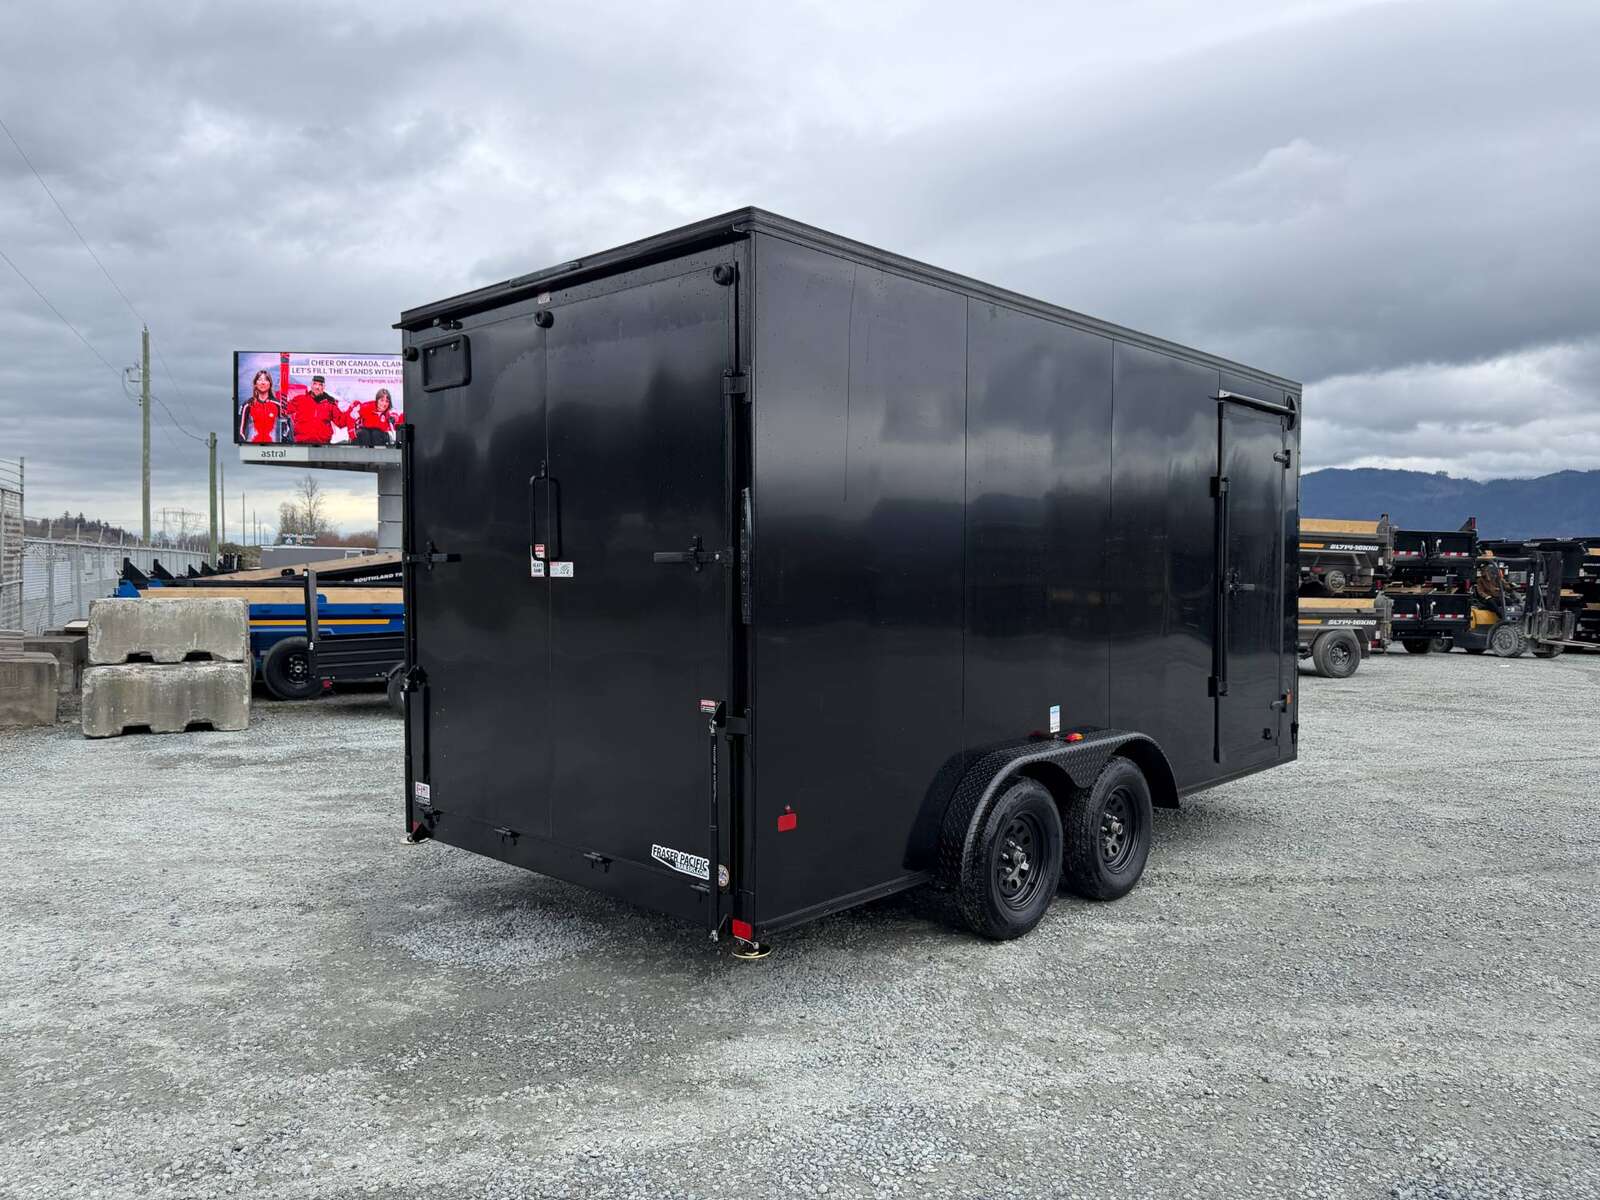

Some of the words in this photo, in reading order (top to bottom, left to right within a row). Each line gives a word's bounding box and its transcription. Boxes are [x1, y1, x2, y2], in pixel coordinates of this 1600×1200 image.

[261, 449, 287, 458] astral
[353, 573, 394, 583] SOUTHLAND
[653, 845, 679, 862] FRASER
[680, 853, 708, 872] PACIFIC
